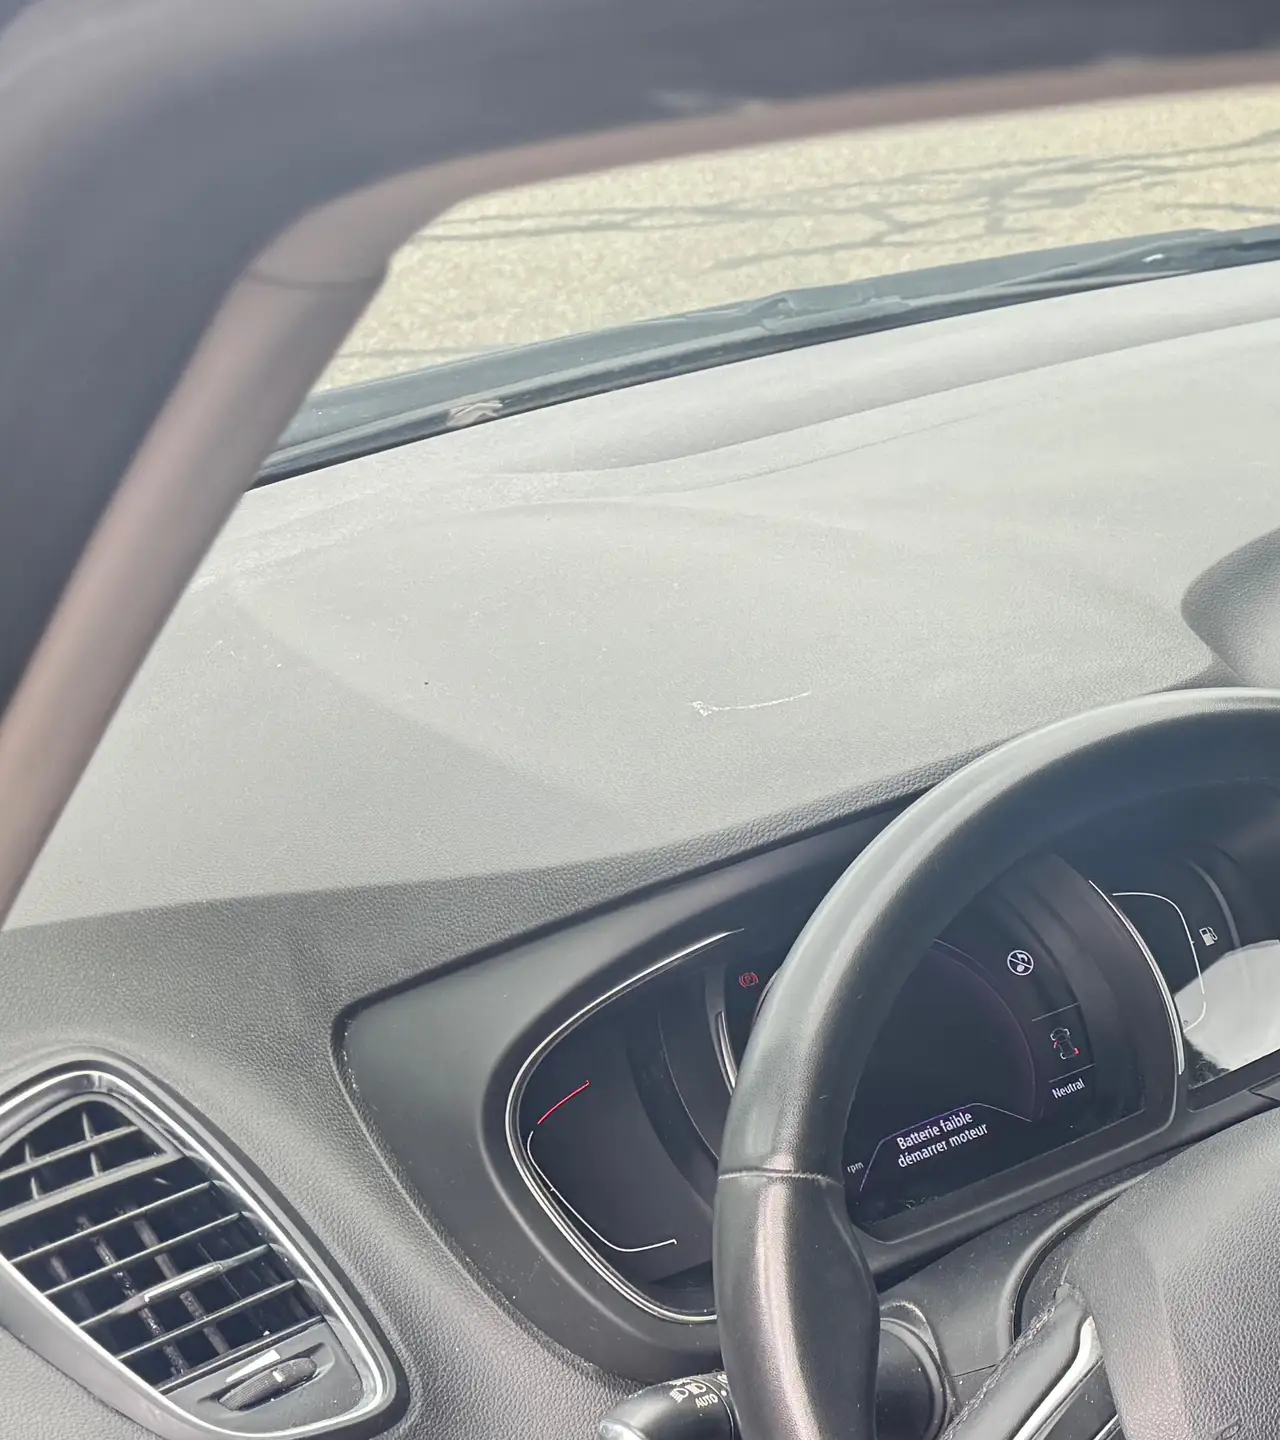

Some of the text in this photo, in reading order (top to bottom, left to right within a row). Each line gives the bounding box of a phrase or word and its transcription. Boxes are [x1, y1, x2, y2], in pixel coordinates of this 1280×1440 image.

[1051, 1077, 1086, 1099] Neutral
[896, 1111, 974, 1150] Batterie faible
[897, 1123, 989, 1169] démarrer moteur
[694, 1393, 719, 1409] AUTO
